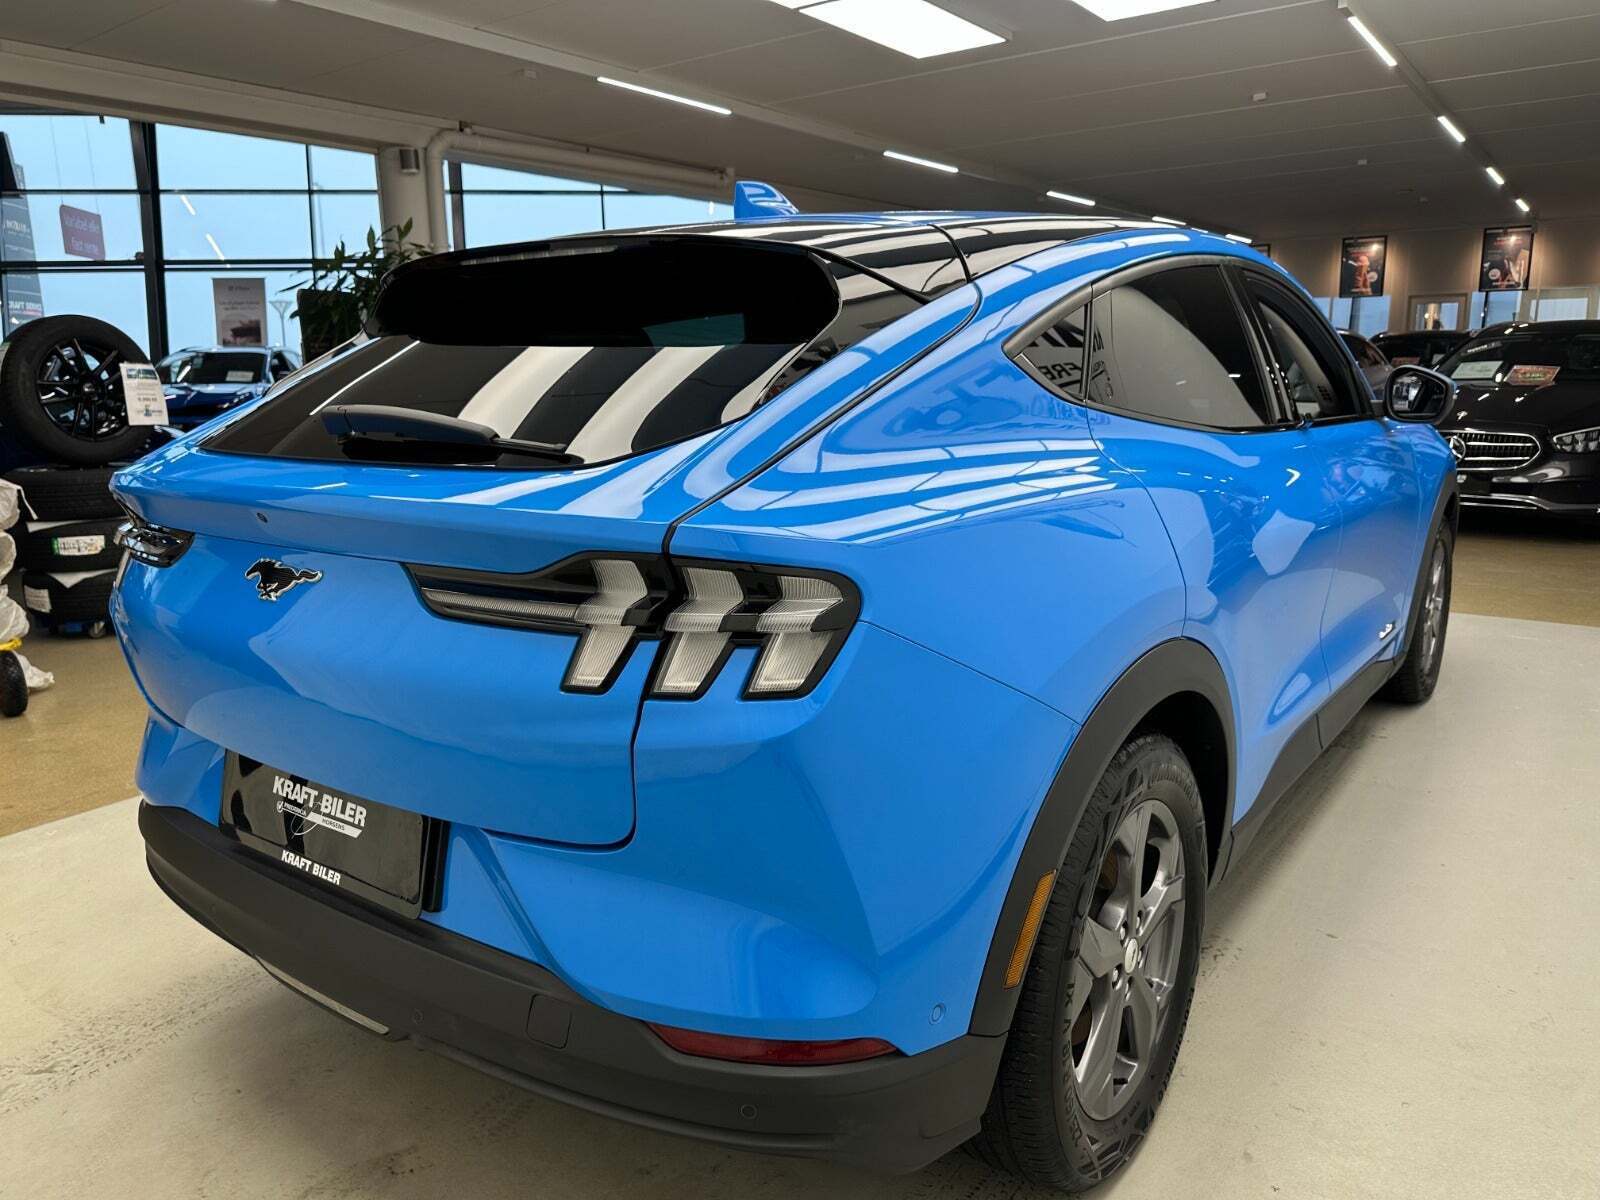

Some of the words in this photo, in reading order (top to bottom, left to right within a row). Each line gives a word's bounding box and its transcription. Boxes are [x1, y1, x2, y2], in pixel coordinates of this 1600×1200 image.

[272, 775, 318, 808] KRAFT
[320, 793, 367, 827] BILER
[321, 817, 346, 831] HORSENS
[281, 849, 312, 872] KRAFT
[312, 862, 341, 886] BILER
